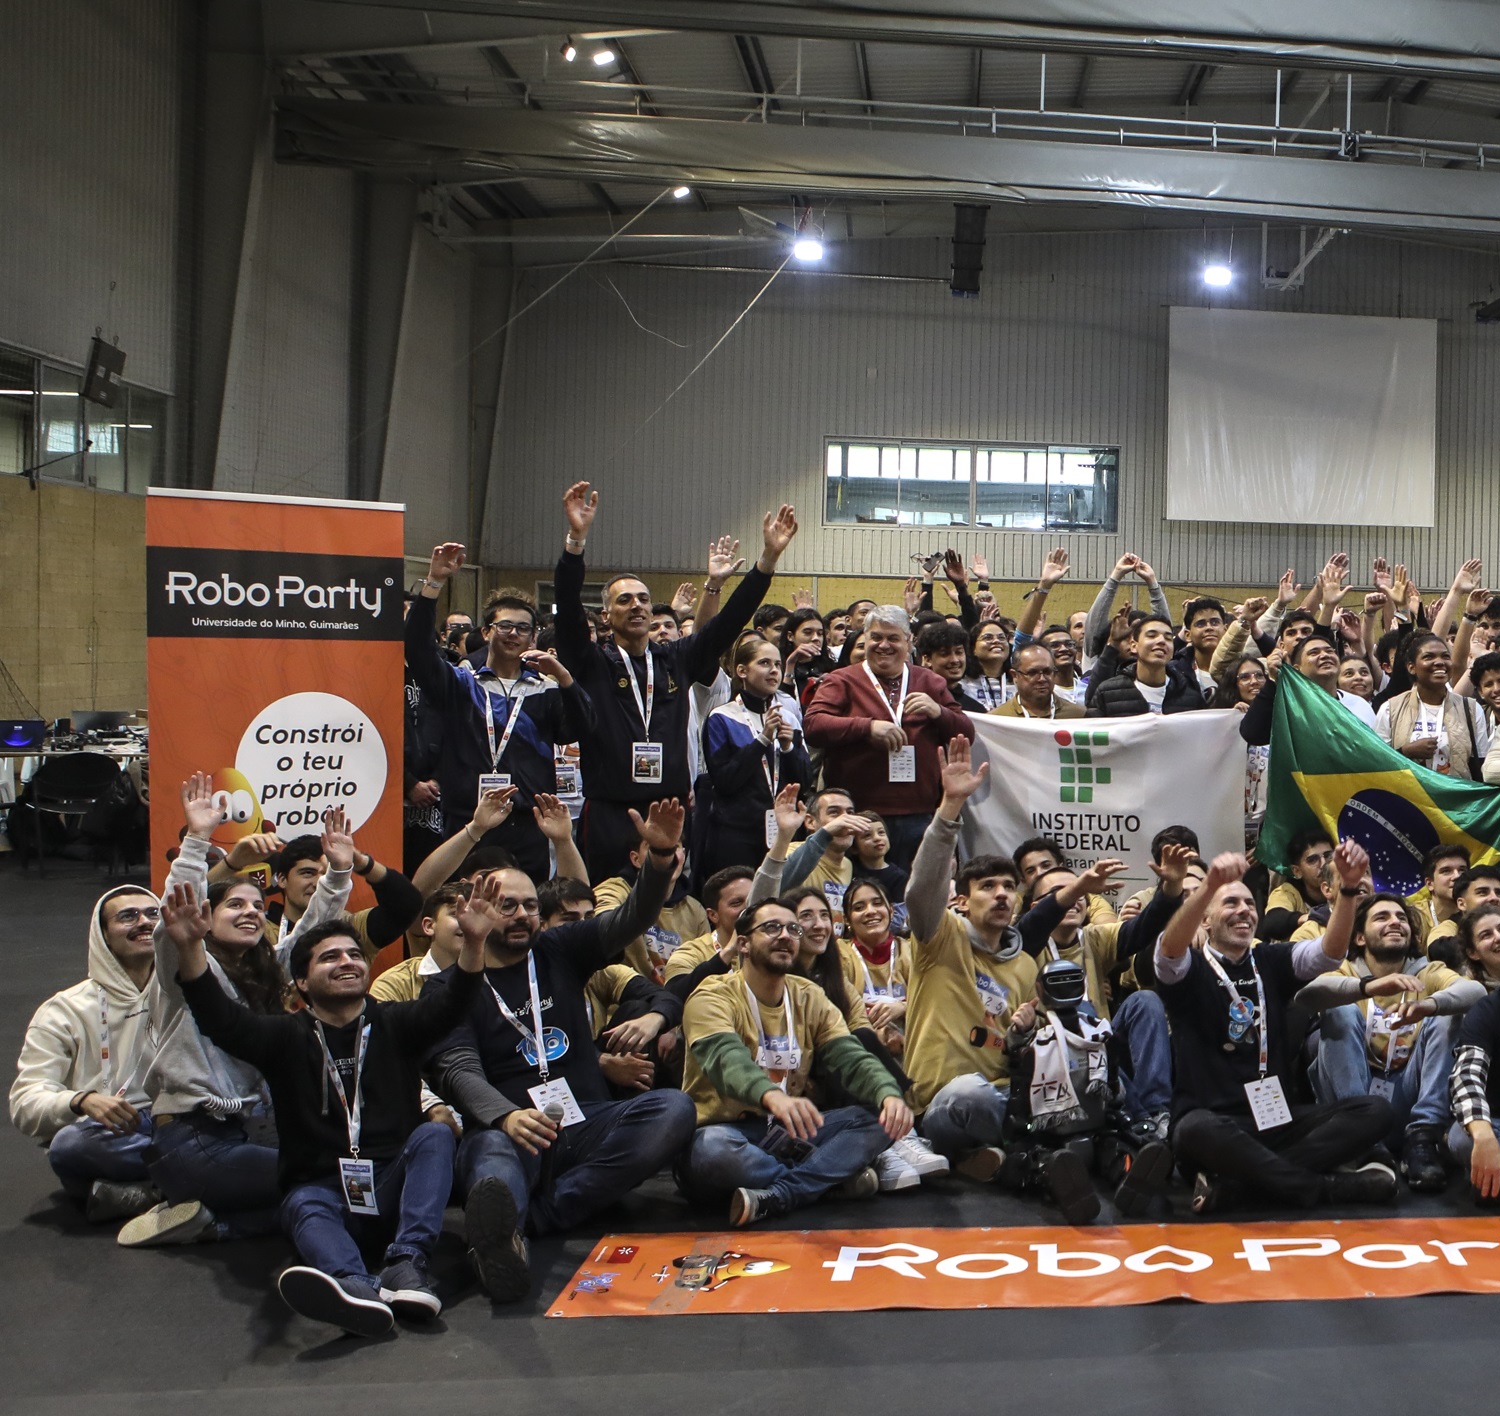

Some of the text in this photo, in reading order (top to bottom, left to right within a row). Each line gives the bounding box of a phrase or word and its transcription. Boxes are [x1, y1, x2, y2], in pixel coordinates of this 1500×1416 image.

[165, 571, 271, 607] Robo
[191, 617, 359, 630] Universidade do Minho. Guimarães
[255, 722, 364, 745] Constrói
[276, 751, 344, 771] o teu
[260, 776, 358, 805] próprio
[1350, 799, 1379, 820] ORDEM
[1032, 812, 1141, 832] INSTITUTO
[822, 1242, 1214, 1282] Robo
